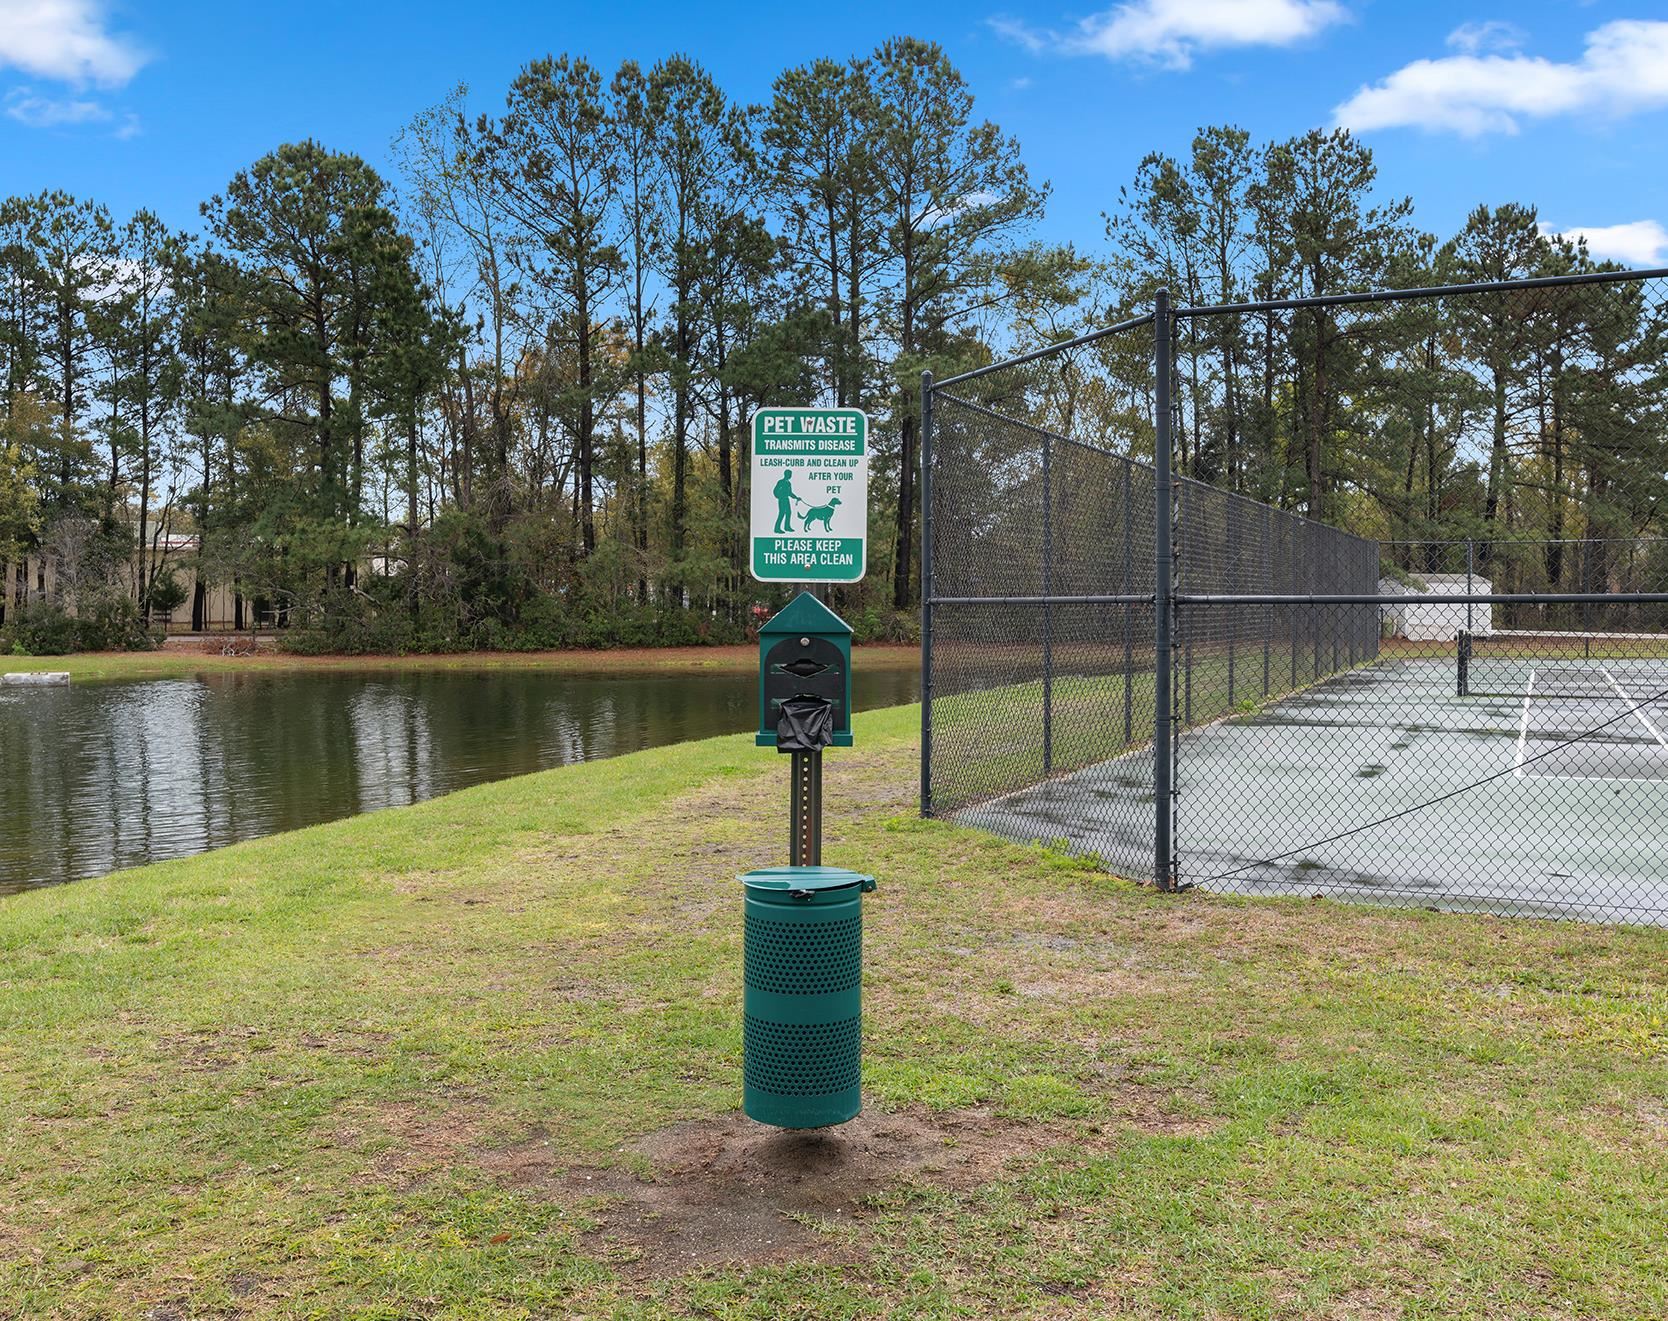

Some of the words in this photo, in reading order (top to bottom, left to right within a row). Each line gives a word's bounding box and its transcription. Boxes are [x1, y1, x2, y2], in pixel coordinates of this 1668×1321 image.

[764, 416, 794, 433] PET
[800, 416, 856, 433] WASTE
[765, 439, 816, 450] TRANSMITS
[818, 440, 855, 450] DISEASE
[760, 458, 804, 466] LEASH-CURB
[809, 472, 831, 480] AFTER
[775, 540, 812, 551] PLEASE
[816, 540, 841, 550] KEEP
[764, 553, 787, 564] THIS
[790, 553, 817, 564] AREA
[820, 554, 853, 565] CLEAN
